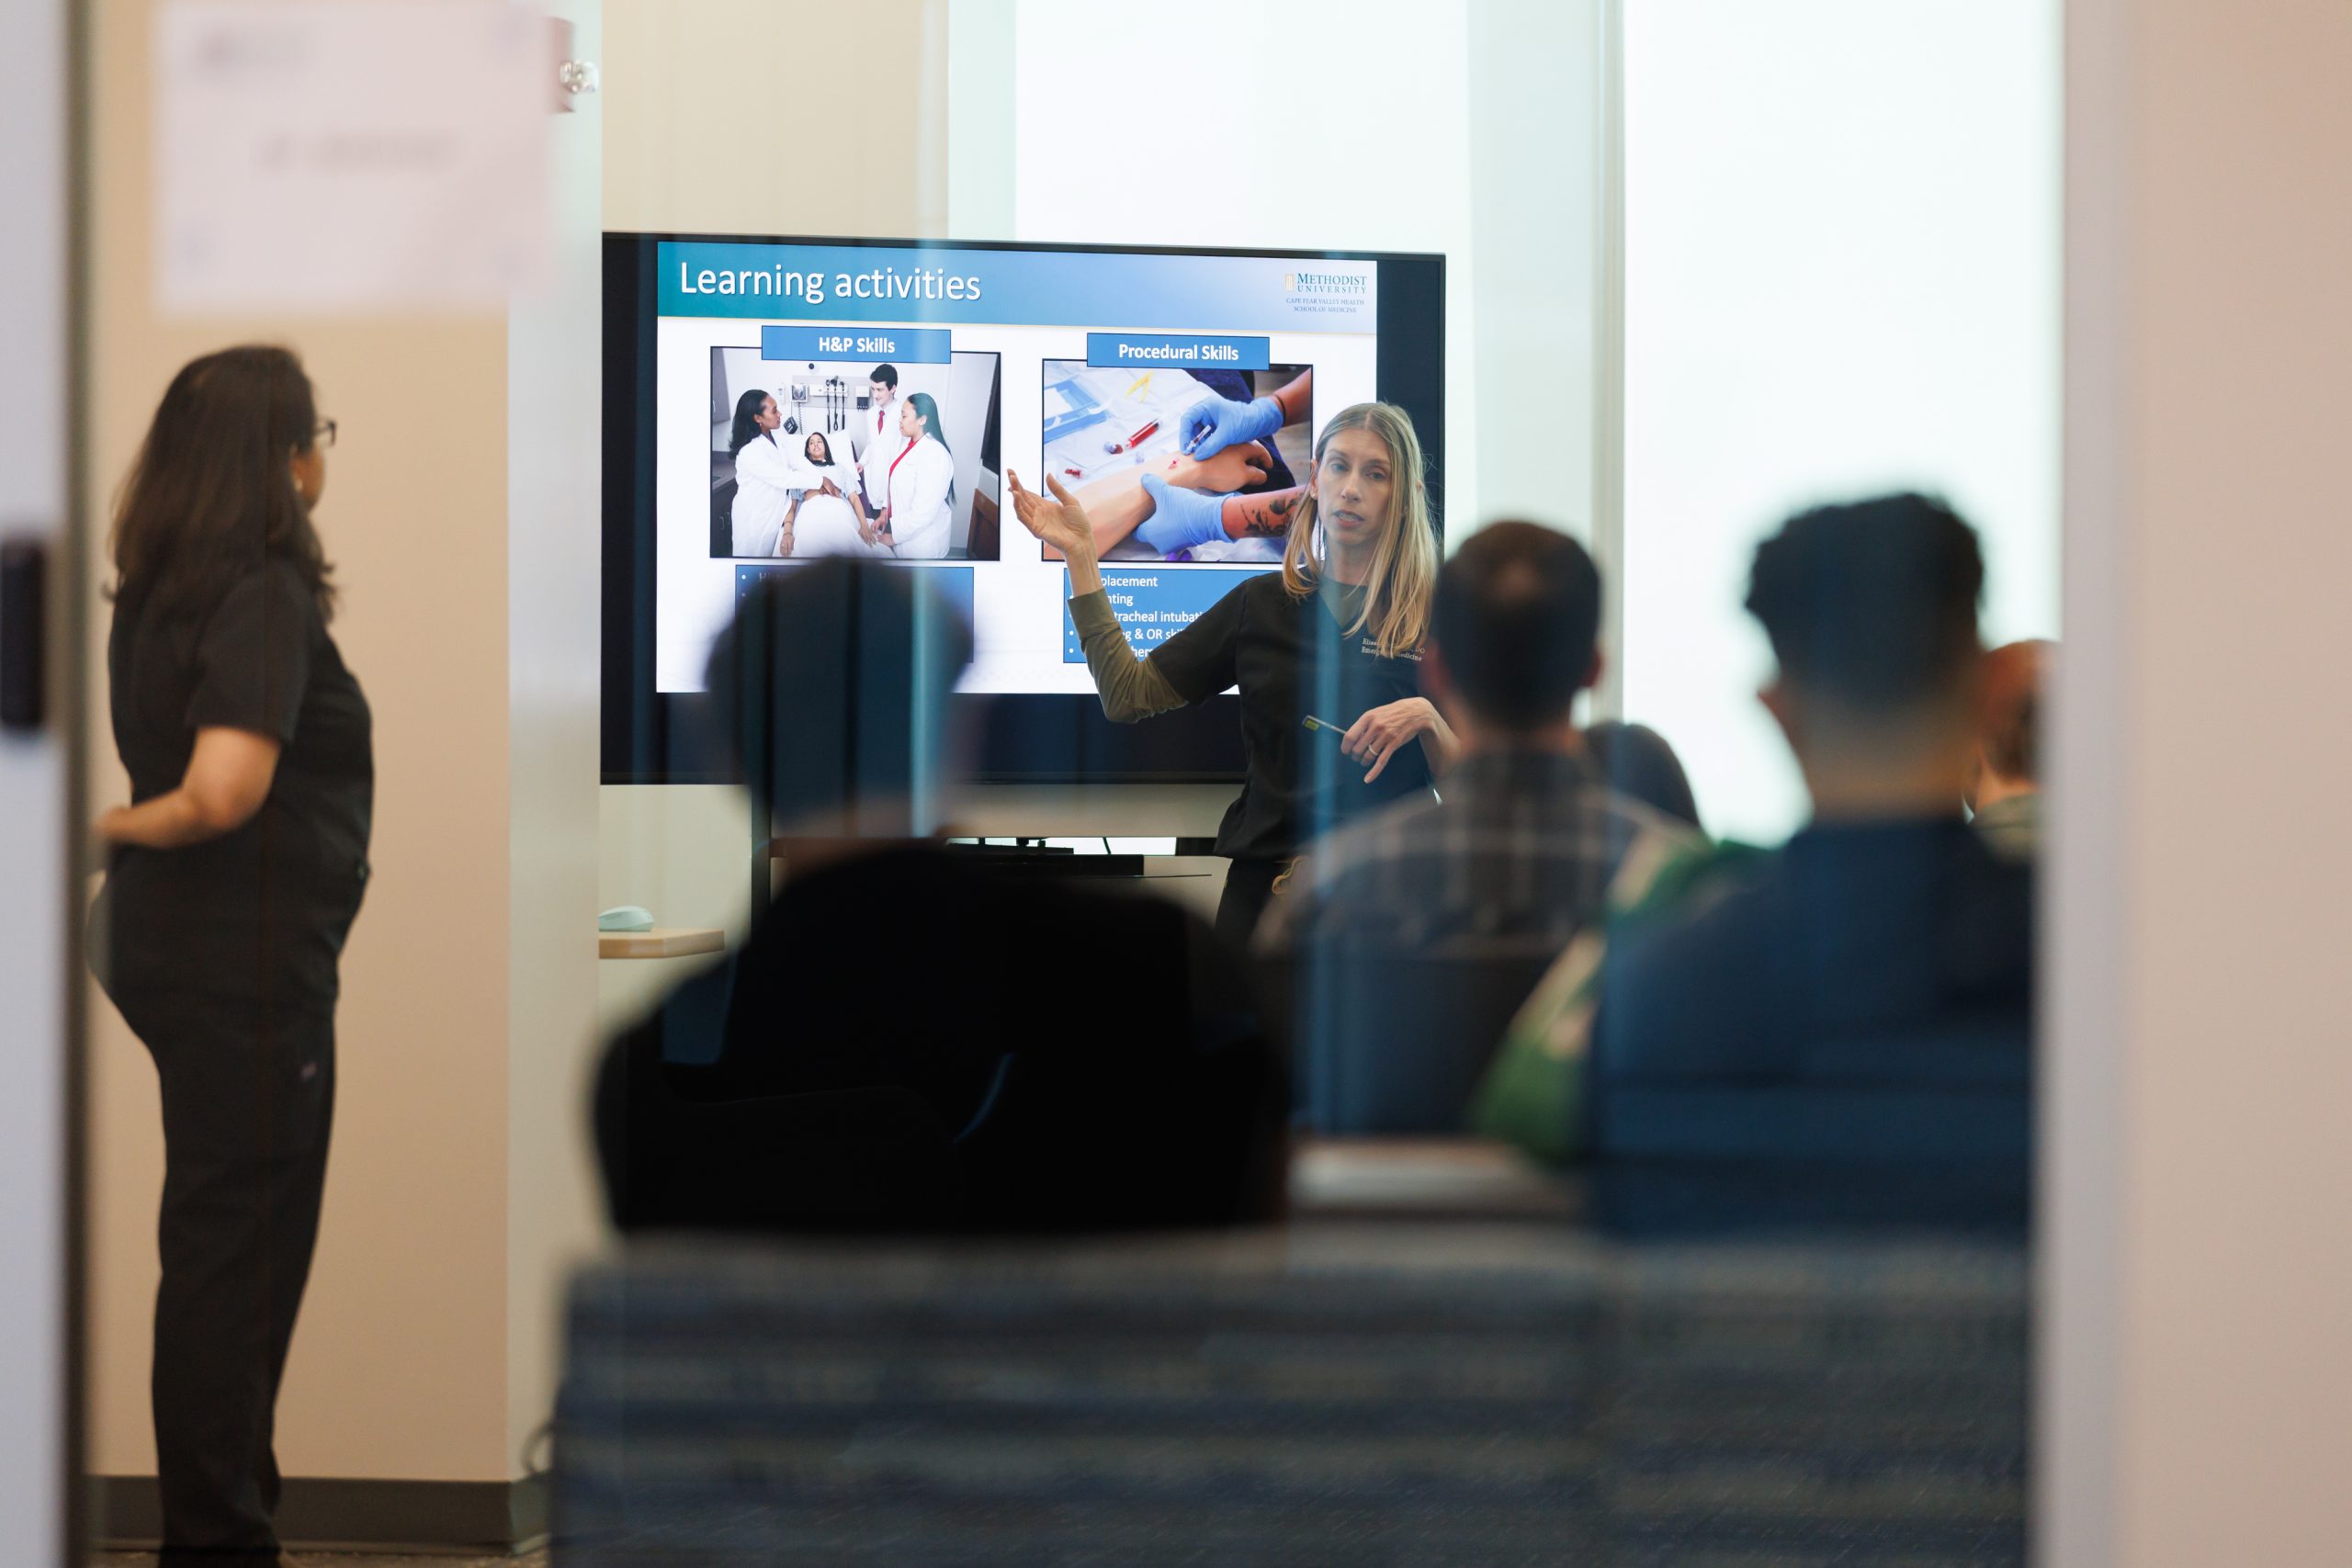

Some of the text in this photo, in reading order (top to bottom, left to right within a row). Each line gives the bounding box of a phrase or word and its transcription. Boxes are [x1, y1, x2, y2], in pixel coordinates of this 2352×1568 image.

[681, 261, 982, 305] Learning activities
[1297, 273, 1367, 286] METHODIST
[1297, 285, 1367, 294] UNIVERSITY
[819, 336, 896, 354] H&P Skills
[1118, 344, 1239, 361] Procedural Skills
[1114, 610, 1158, 623] tracheal
[1134, 627, 1144, 639] &
[1146, 628, 1163, 640] OR
